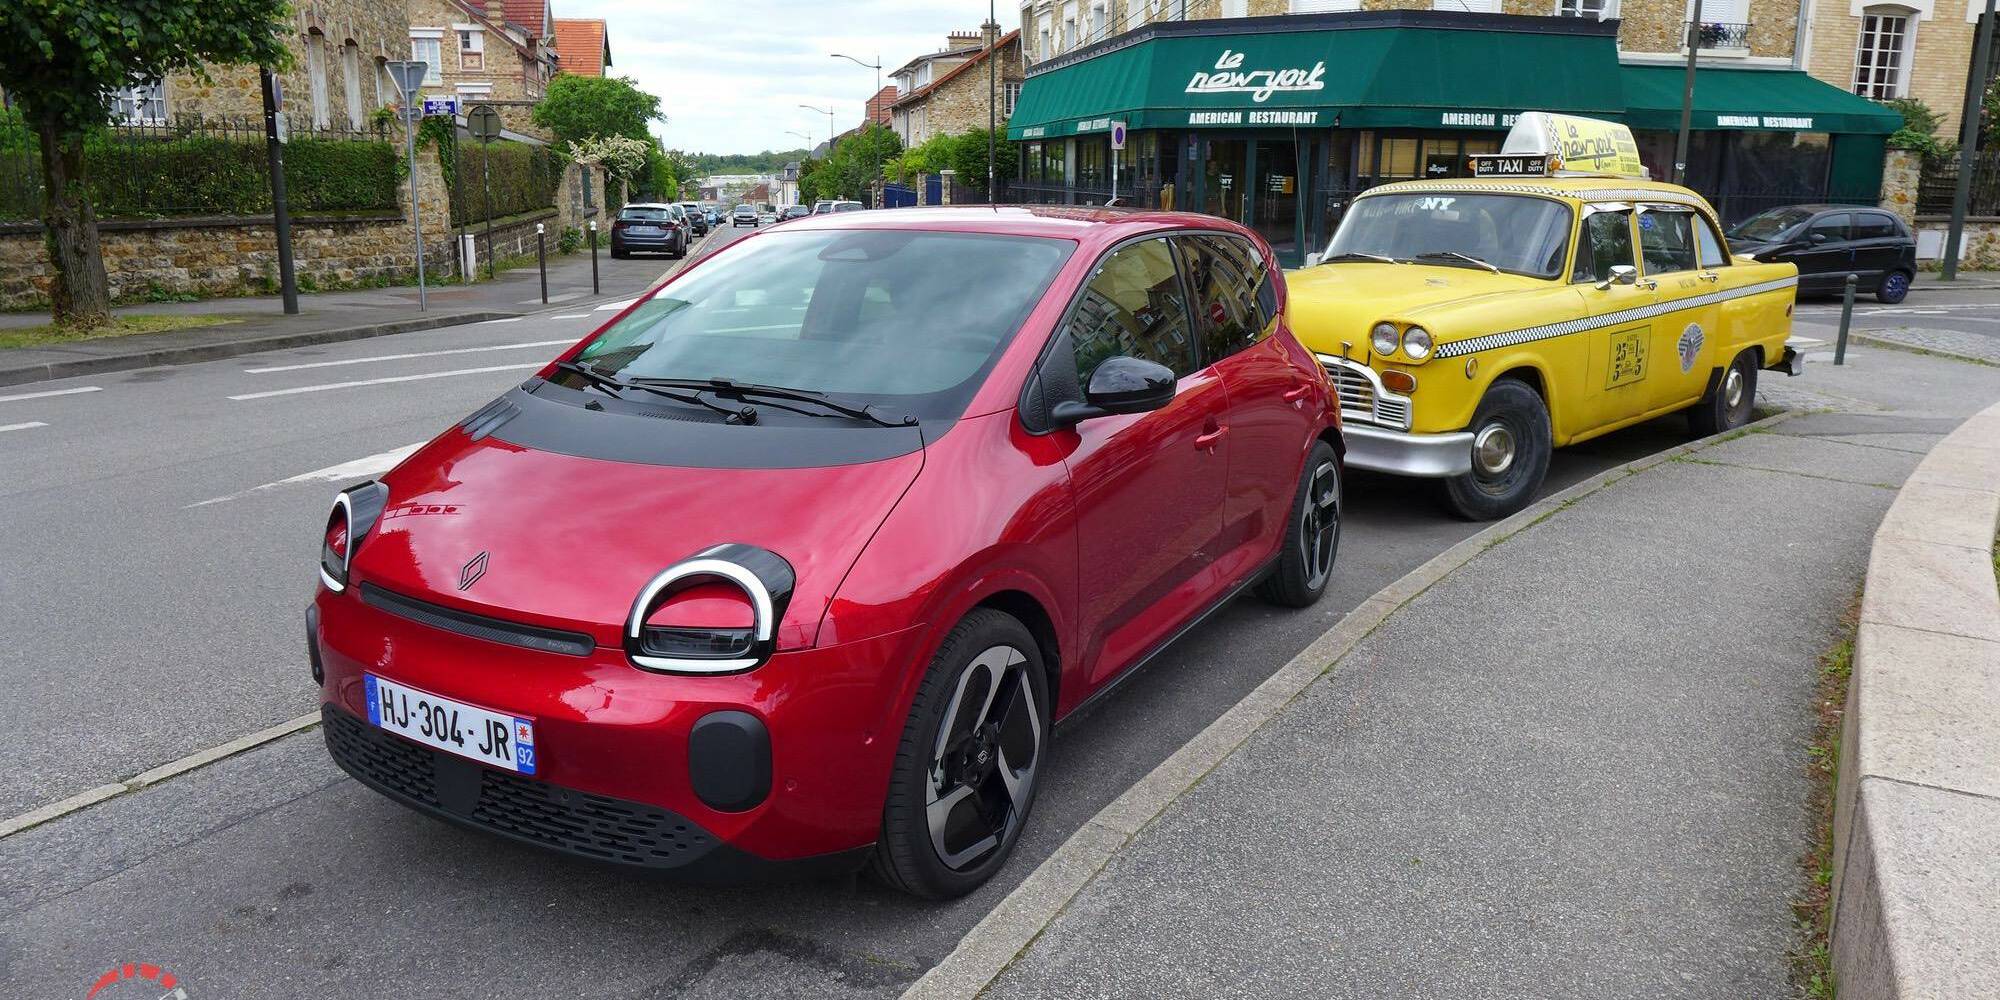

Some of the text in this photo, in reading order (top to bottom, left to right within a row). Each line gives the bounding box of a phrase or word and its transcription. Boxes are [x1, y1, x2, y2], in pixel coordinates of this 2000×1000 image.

[1214, 49, 1245, 69] Le
[1189, 111, 1318, 125] AMERICAN RESTAURANT
[1441, 112, 1521, 127] AMERICAN RES
[1717, 115, 1813, 129] AMERICAN RESTAURANT
[1497, 159, 1523, 173] TAXI
[1420, 197, 1456, 210] NY
[381, 686, 511, 761] HJ-304-JR
[517, 746, 534, 767] 92
